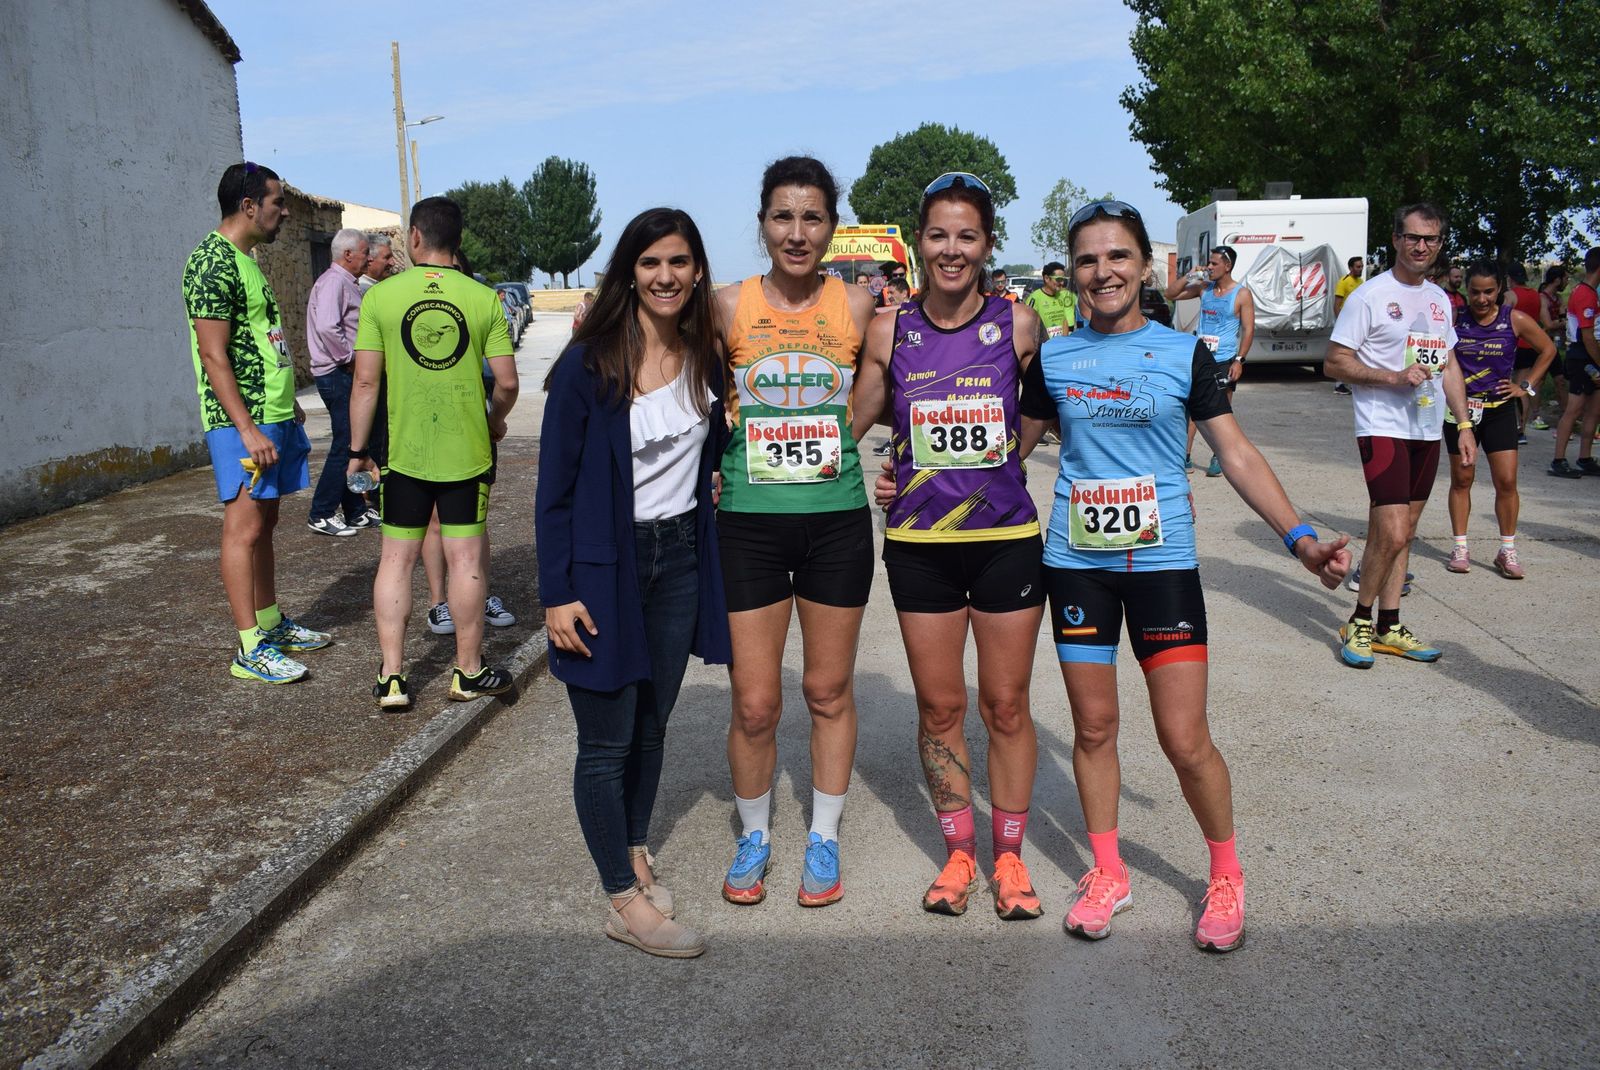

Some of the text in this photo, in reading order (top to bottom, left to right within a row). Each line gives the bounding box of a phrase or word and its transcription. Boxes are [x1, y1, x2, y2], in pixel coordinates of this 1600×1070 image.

[827, 243, 890, 253] MBULANCIA
[406, 302, 463, 322] CORRECAMINOS
[746, 343, 842, 364] CLUB DEPORTIVO
[1416, 348, 1439, 365] 356
[418, 356, 457, 370] Carbajosa
[753, 373, 834, 390] ALCER
[905, 370, 937, 382] Jamón
[956, 377, 991, 387] PRIM
[912, 404, 1003, 426] bedunia
[1095, 405, 1149, 420] FLOWERS
[748, 421, 839, 442] bedunia
[930, 425, 988, 453] 388
[765, 440, 823, 467] 355
[1071, 482, 1155, 506] bedunia
[1084, 505, 1141, 534] 320
[1143, 631, 1192, 641] bedunia
